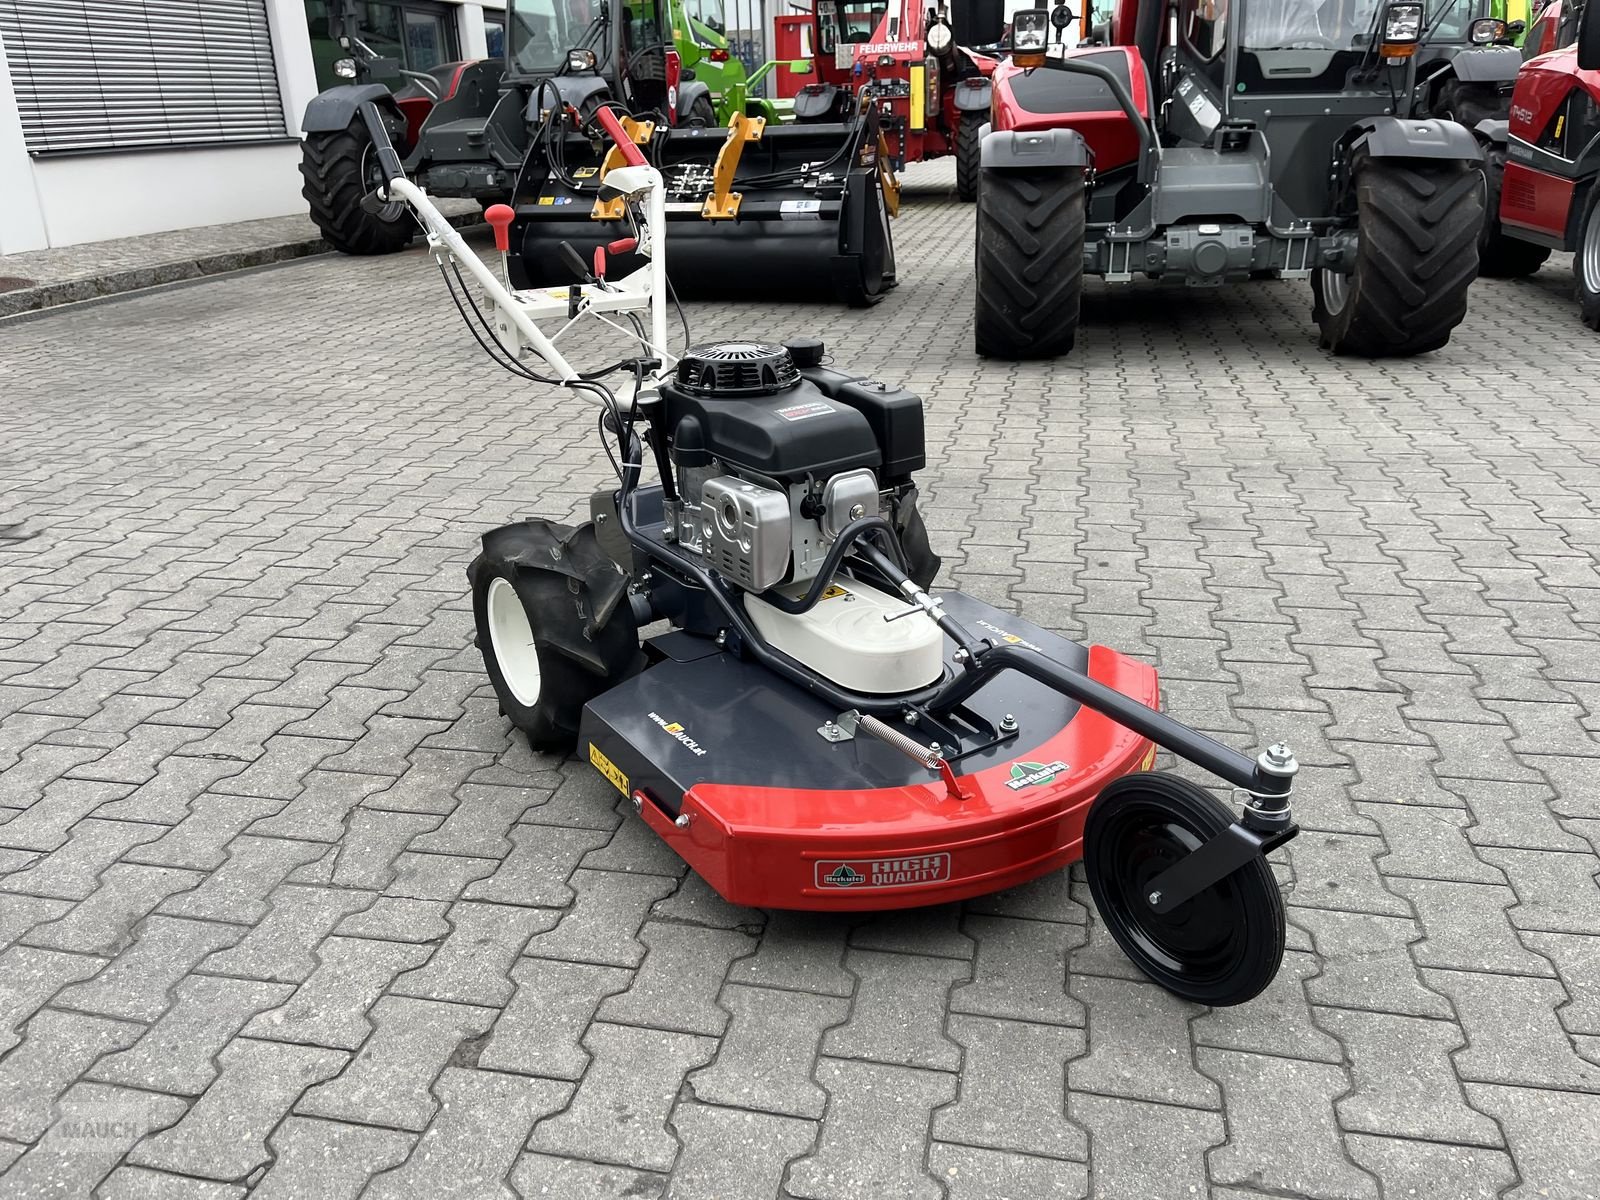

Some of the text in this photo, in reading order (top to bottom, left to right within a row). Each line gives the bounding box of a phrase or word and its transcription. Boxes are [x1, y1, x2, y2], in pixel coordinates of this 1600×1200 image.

[859, 41, 919, 54] FEUERWEHR
[871, 856, 942, 874] HIGH
[825, 873, 865, 883] Herkules
[871, 868, 940, 886] QUALITY
